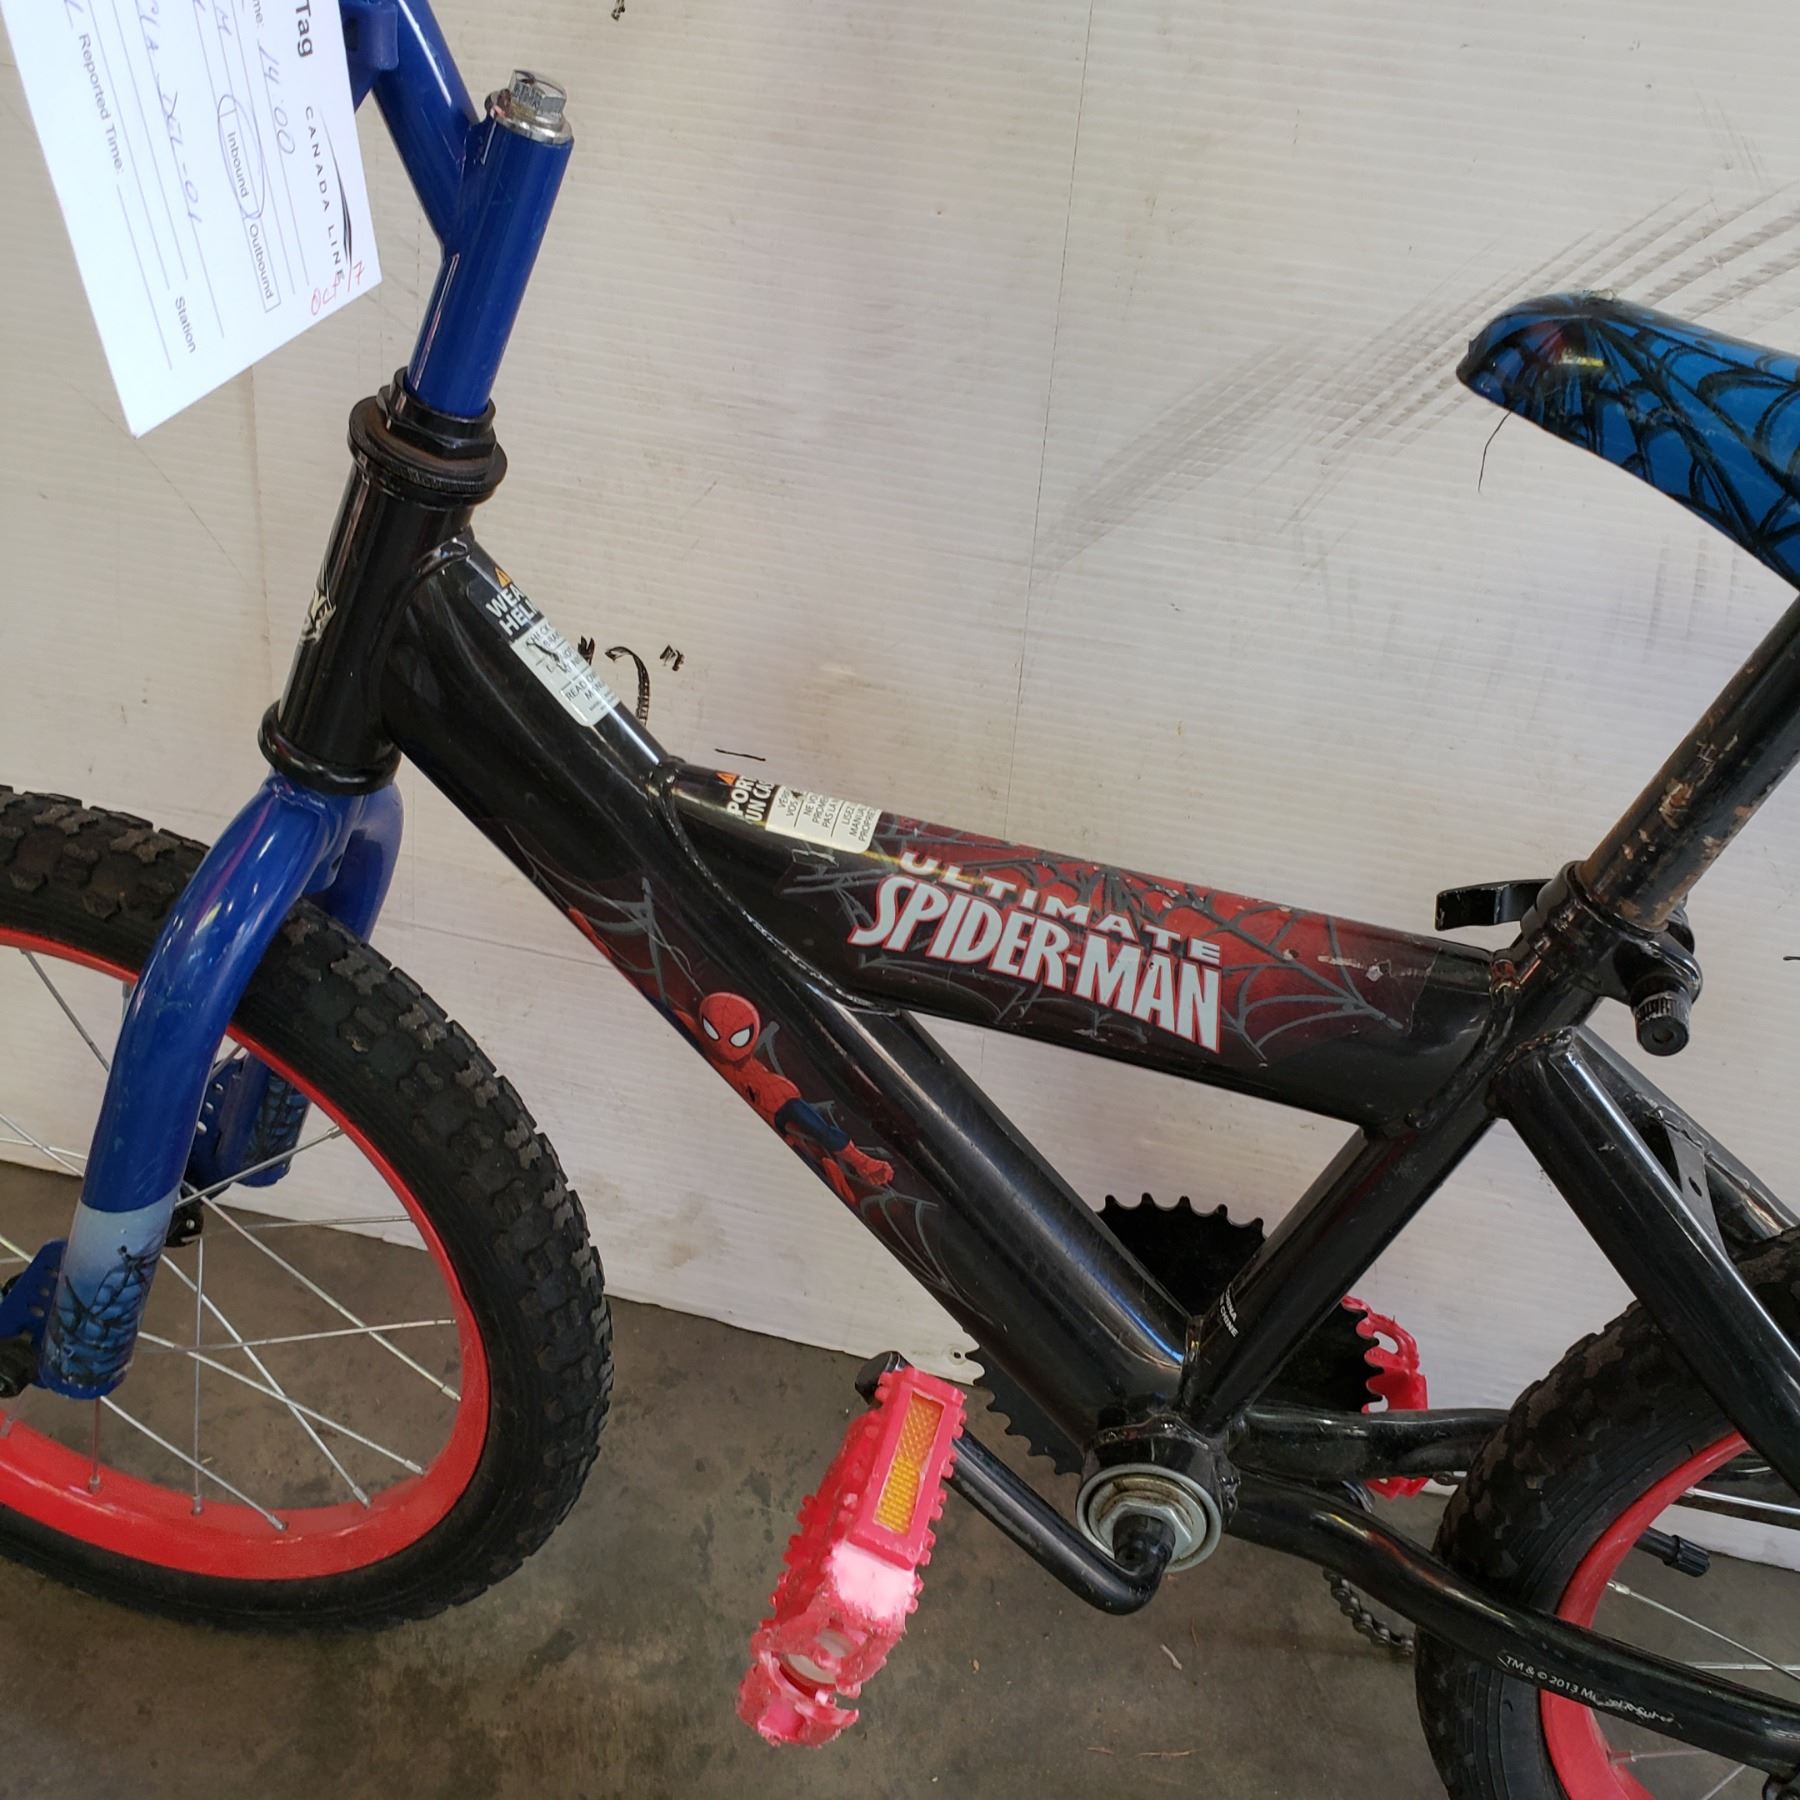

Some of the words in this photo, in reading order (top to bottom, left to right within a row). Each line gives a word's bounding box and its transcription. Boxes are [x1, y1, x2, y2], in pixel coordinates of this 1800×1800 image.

[296, 0, 314, 58] Tag
[78, 33, 111, 120] Reported
[104, 126, 125, 175] Time:
[228, 131, 250, 199] Inbound
[305, 105, 331, 213] CANADA
[327, 225, 346, 282] LINE
[249, 222, 274, 300] Outbound
[175, 296, 197, 355] Station
[485, 584, 525, 618] WEA
[499, 599, 539, 636] HEL
[565, 681, 588, 701] READ
[745, 799, 767, 821] UN
[821, 813, 834, 828] PAS
[900, 850, 1222, 966] ULTIMATE
[847, 874, 1222, 1054] SPIDER-MAN
[1220, 1305, 1239, 1337] CHINE
[1506, 1655, 1524, 1672] TM
[1525, 1666, 1536, 1676] &
[1549, 1675, 1579, 1694] 2013
